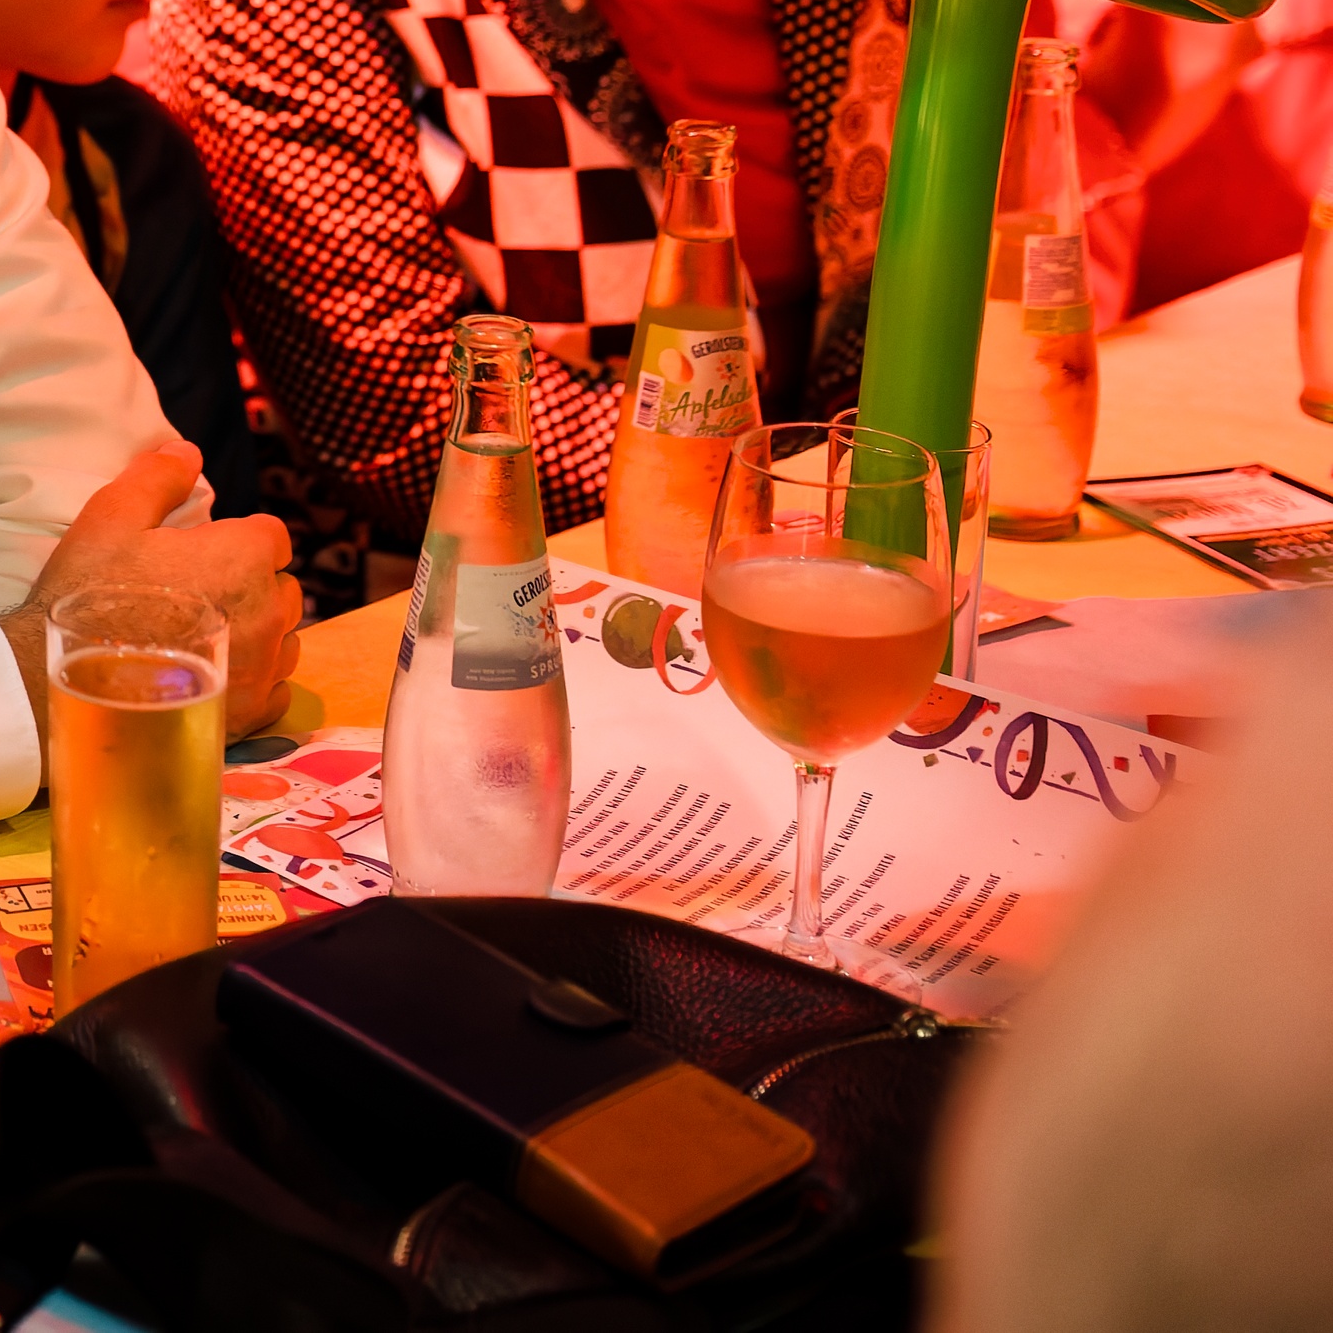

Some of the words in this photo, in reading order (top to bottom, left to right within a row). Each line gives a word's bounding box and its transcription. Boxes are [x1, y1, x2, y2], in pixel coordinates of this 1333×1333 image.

[571, 769, 618, 814] VORSITZENDEN
[605, 765, 647, 808] WALLENDORF
[663, 792, 710, 841] KATASTROPHEN
[696, 802, 731, 836] KRUCHTEN
[837, 791, 873, 840] KÖRPERICH
[860, 853, 896, 889] KRUCHTEN
[929, 873, 971, 917] BOLLENDORF
[959, 872, 1002, 920] WALLENDORF
